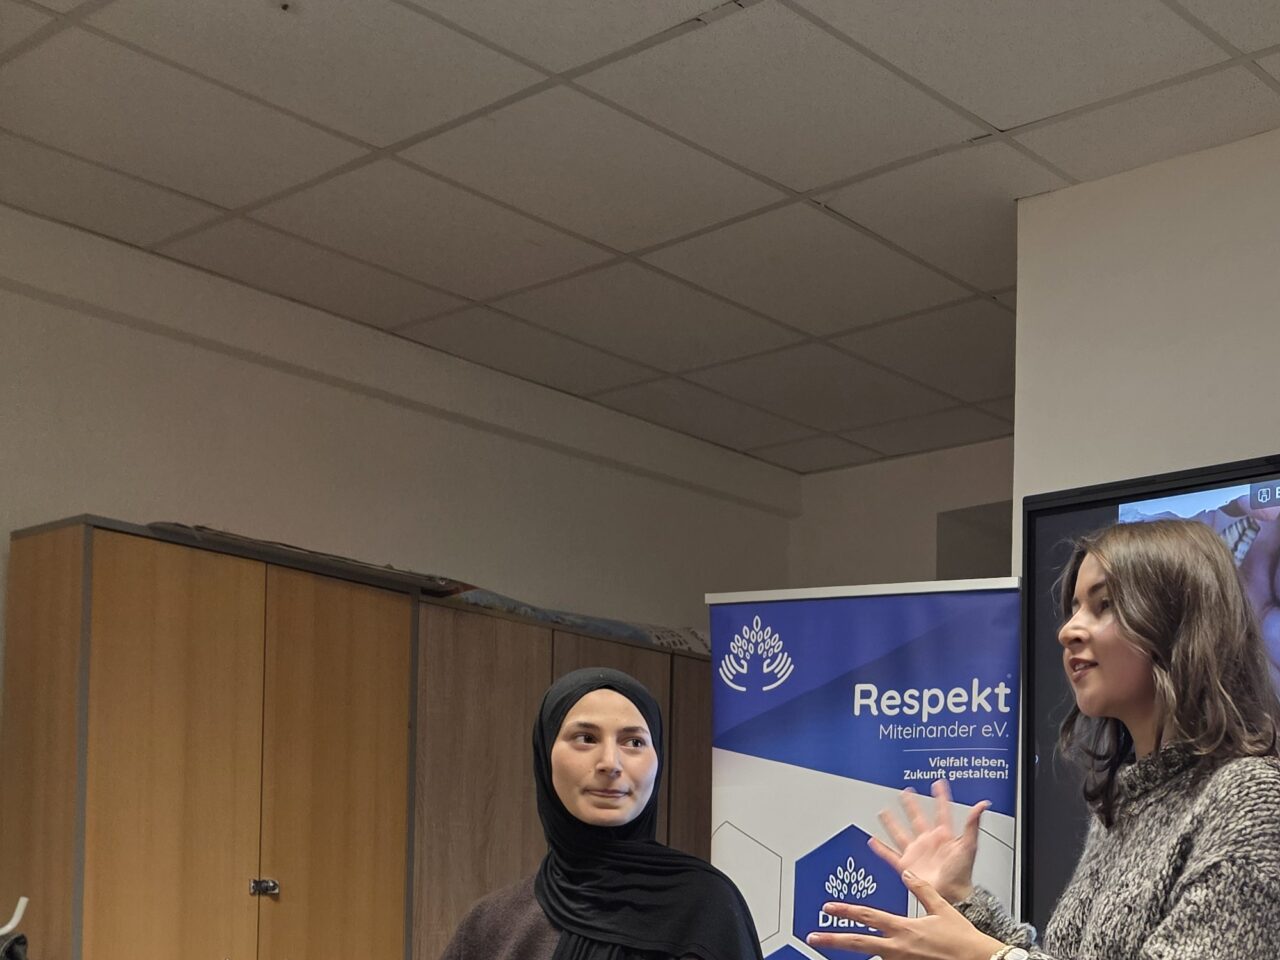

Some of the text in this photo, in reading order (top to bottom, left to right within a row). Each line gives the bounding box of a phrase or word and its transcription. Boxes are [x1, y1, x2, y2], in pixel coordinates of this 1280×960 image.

[853, 677, 1011, 723] Respekt
[879, 721, 1009, 740] Miteinander e.V.
[928, 756, 1009, 769] Vielfalt leben,
[903, 768, 1009, 781] Zukunft gestalten!
